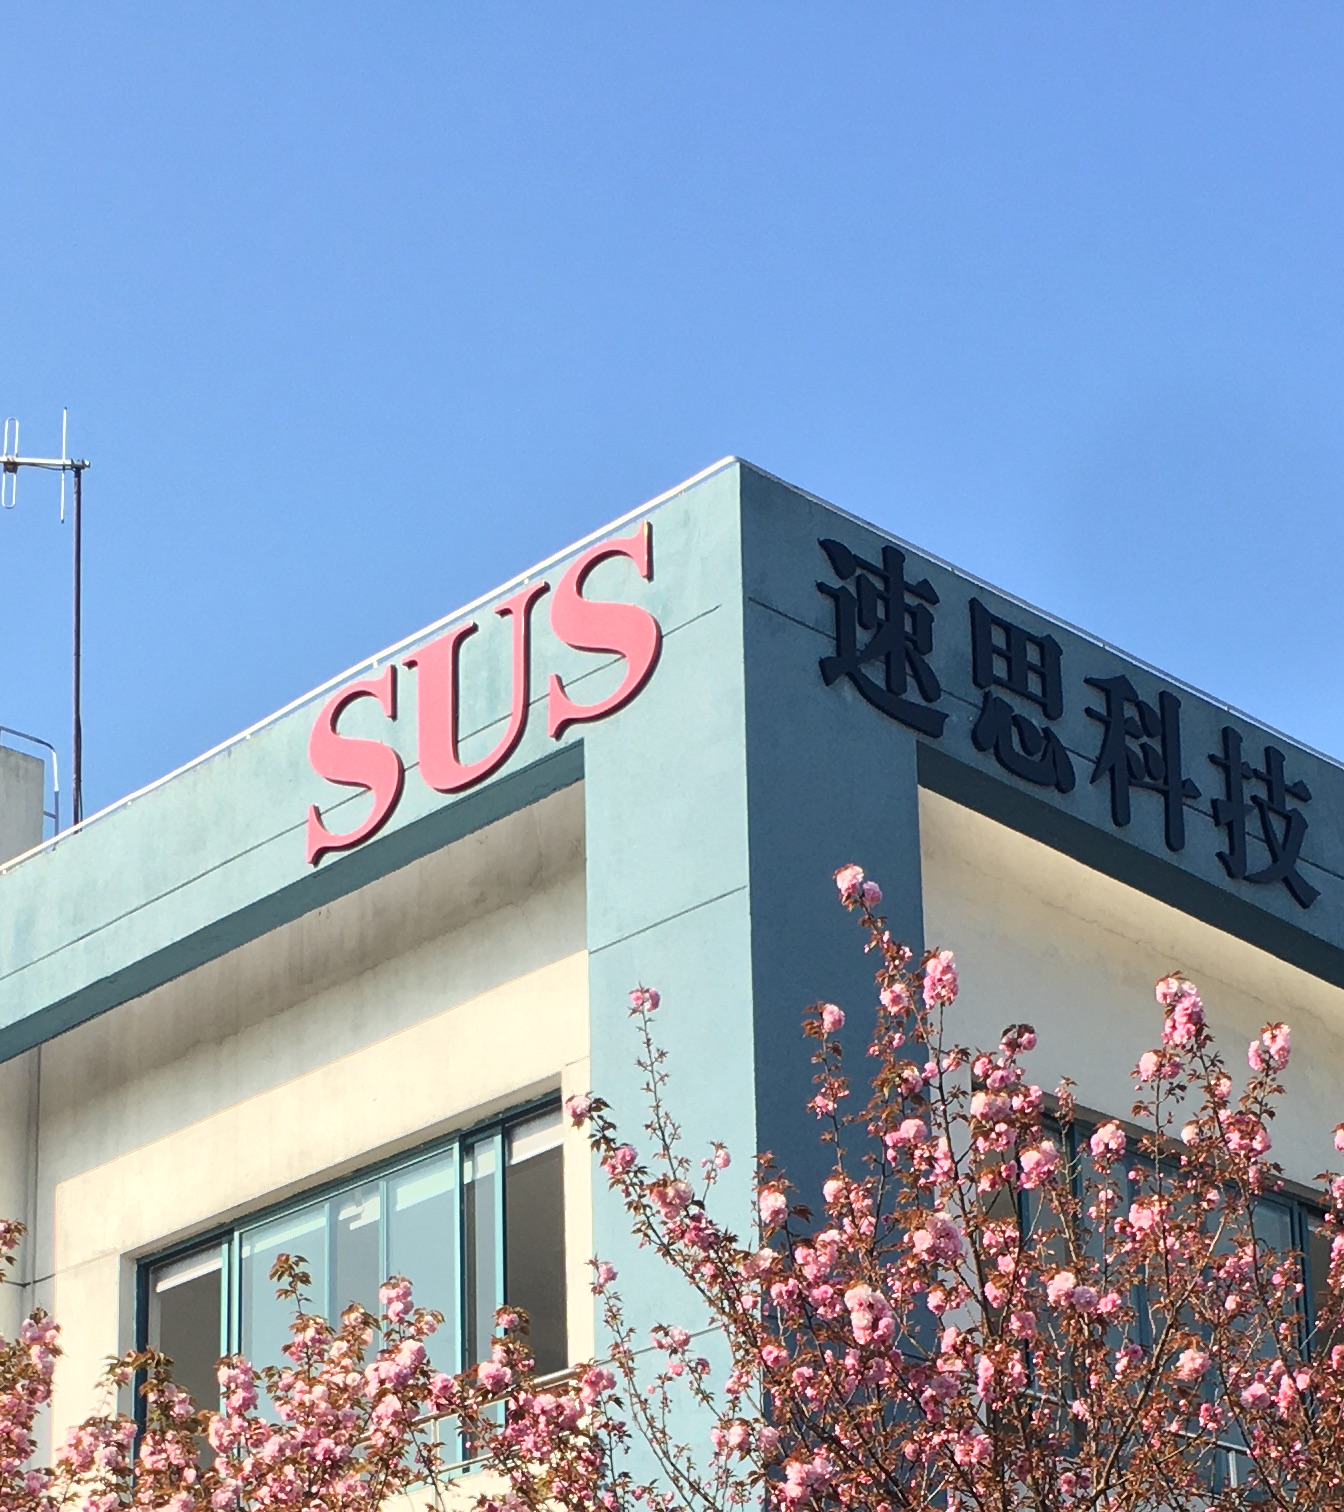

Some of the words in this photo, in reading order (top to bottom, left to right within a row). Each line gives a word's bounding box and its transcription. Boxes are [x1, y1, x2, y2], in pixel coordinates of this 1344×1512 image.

[307, 520, 663, 867] SUS
[815, 538, 1321, 909] 速思科技
